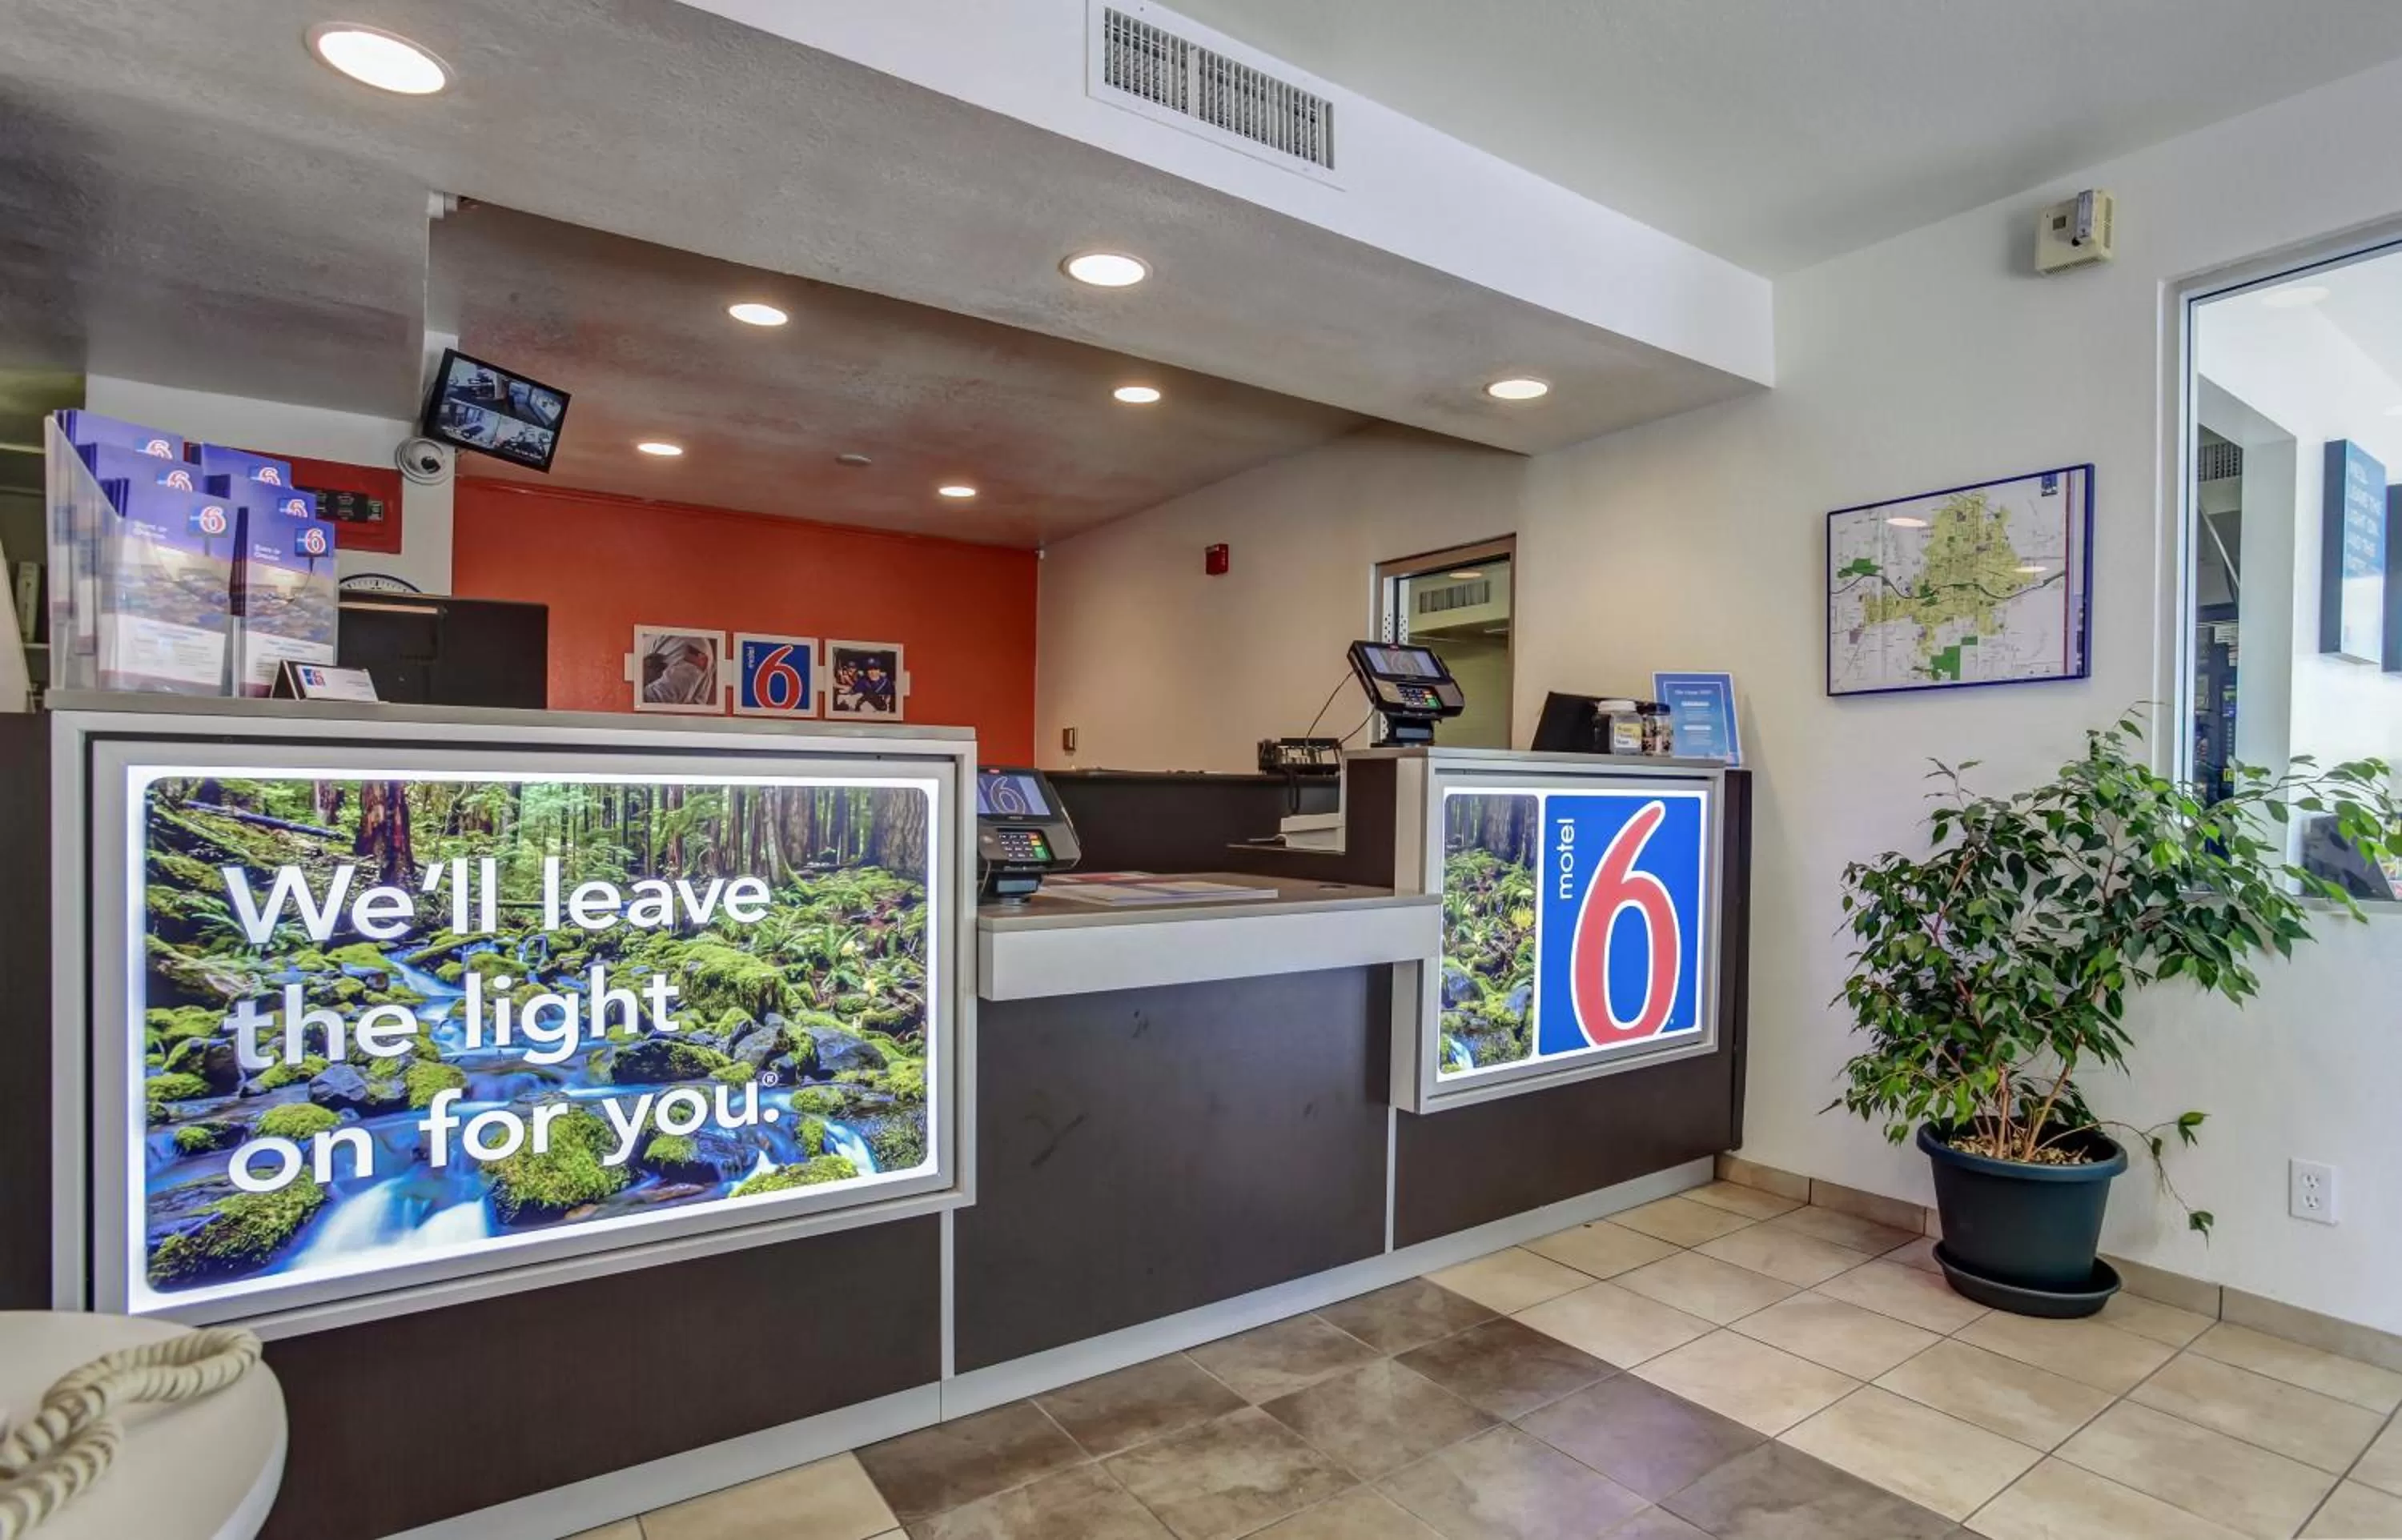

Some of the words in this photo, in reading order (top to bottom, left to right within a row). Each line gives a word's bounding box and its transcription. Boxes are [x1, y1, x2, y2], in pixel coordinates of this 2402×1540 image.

[199, 505, 226, 534] 6
[305, 527, 326, 554] 6
[753, 644, 803, 710] 6
[990, 776, 1025, 815] 6
[222, 857, 496, 944] We'll
[544, 856, 771, 930] leave
[1556, 818, 1575, 900] motel
[1569, 800, 1681, 1049] 6
[223, 984, 418, 1070] the
[465, 965, 680, 1065] light
[228, 1126, 374, 1193] on
[419, 1088, 571, 1168] for
